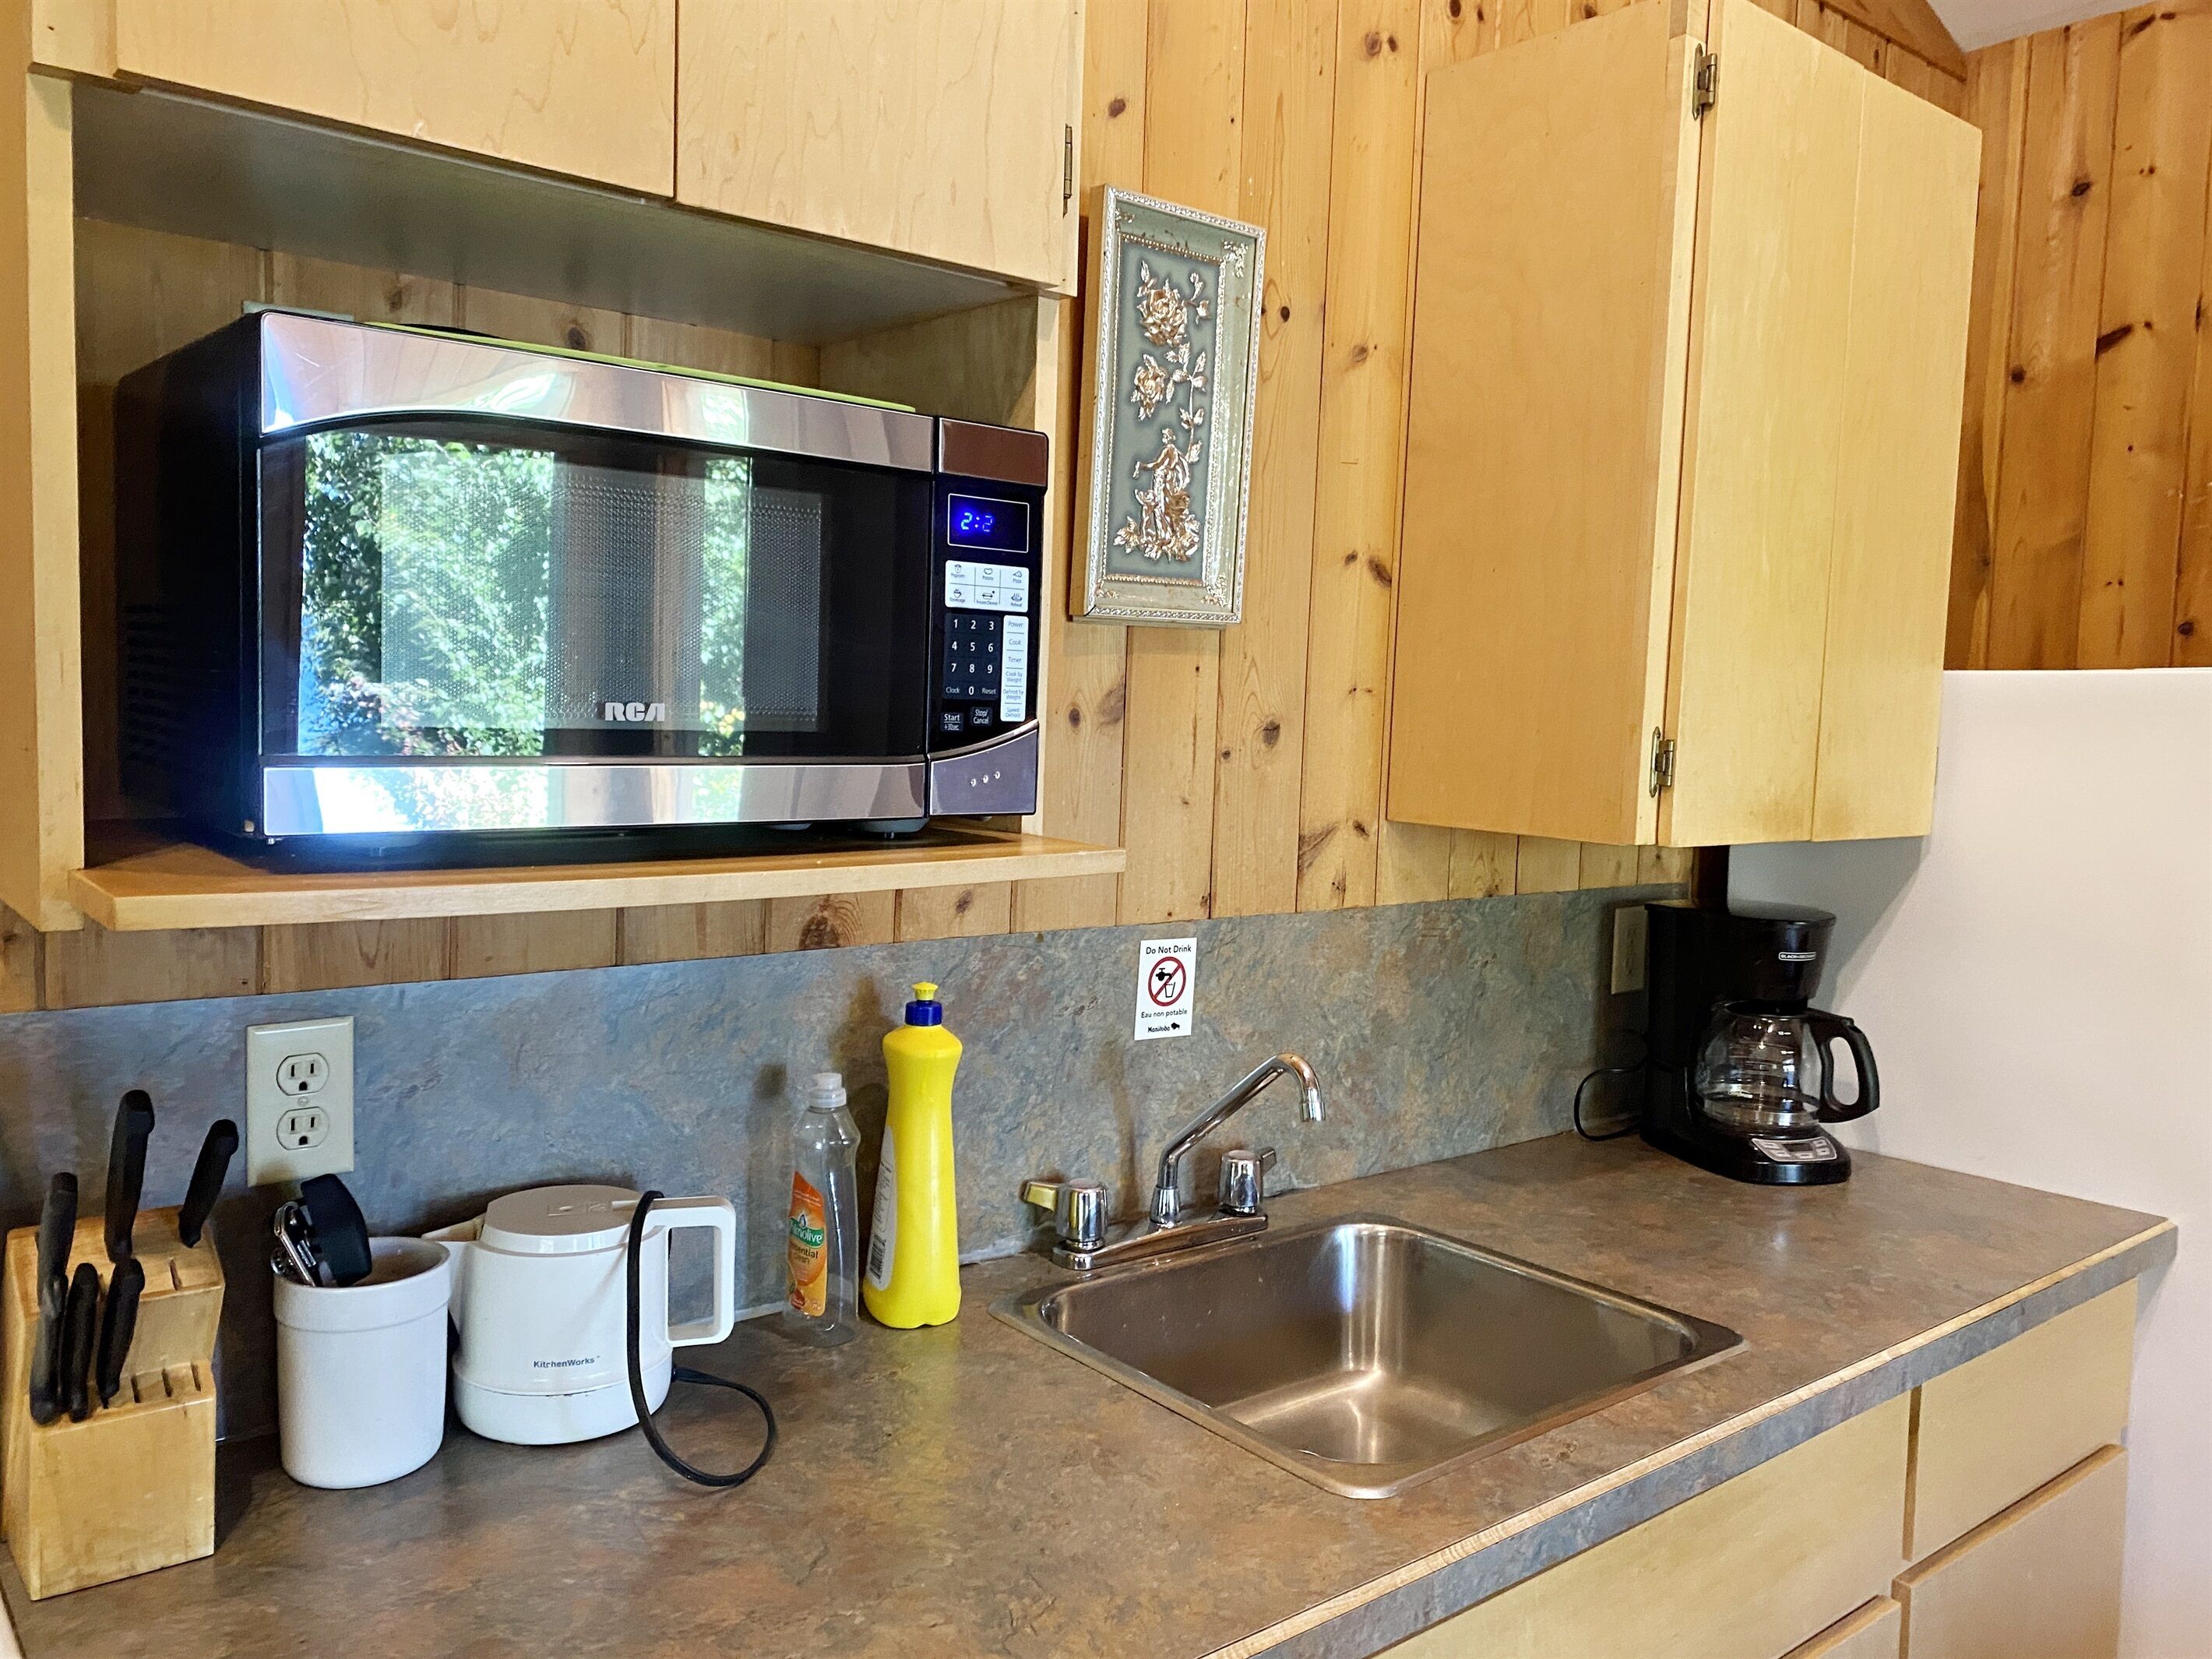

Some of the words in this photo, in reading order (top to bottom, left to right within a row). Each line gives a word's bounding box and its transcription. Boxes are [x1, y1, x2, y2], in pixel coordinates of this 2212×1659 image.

[953, 619, 958, 629] 1
[970, 620, 976, 629] 2
[988, 621, 995, 630] 3
[951, 641, 957, 650] 4
[970, 642, 975, 651] 5
[988, 643, 993, 652] 6
[951, 663, 957, 672] 7
[969, 664, 974, 673] 8
[987, 664, 993, 674] 9
[968, 686, 974, 695] 0
[604, 702, 665, 722] RCA
[1173, 944, 1192, 953] Drink
[1166, 1009, 1188, 1018] potable
[791, 1219, 823, 1245] lmolive
[534, 1358, 595, 1368] KitchenWorks
